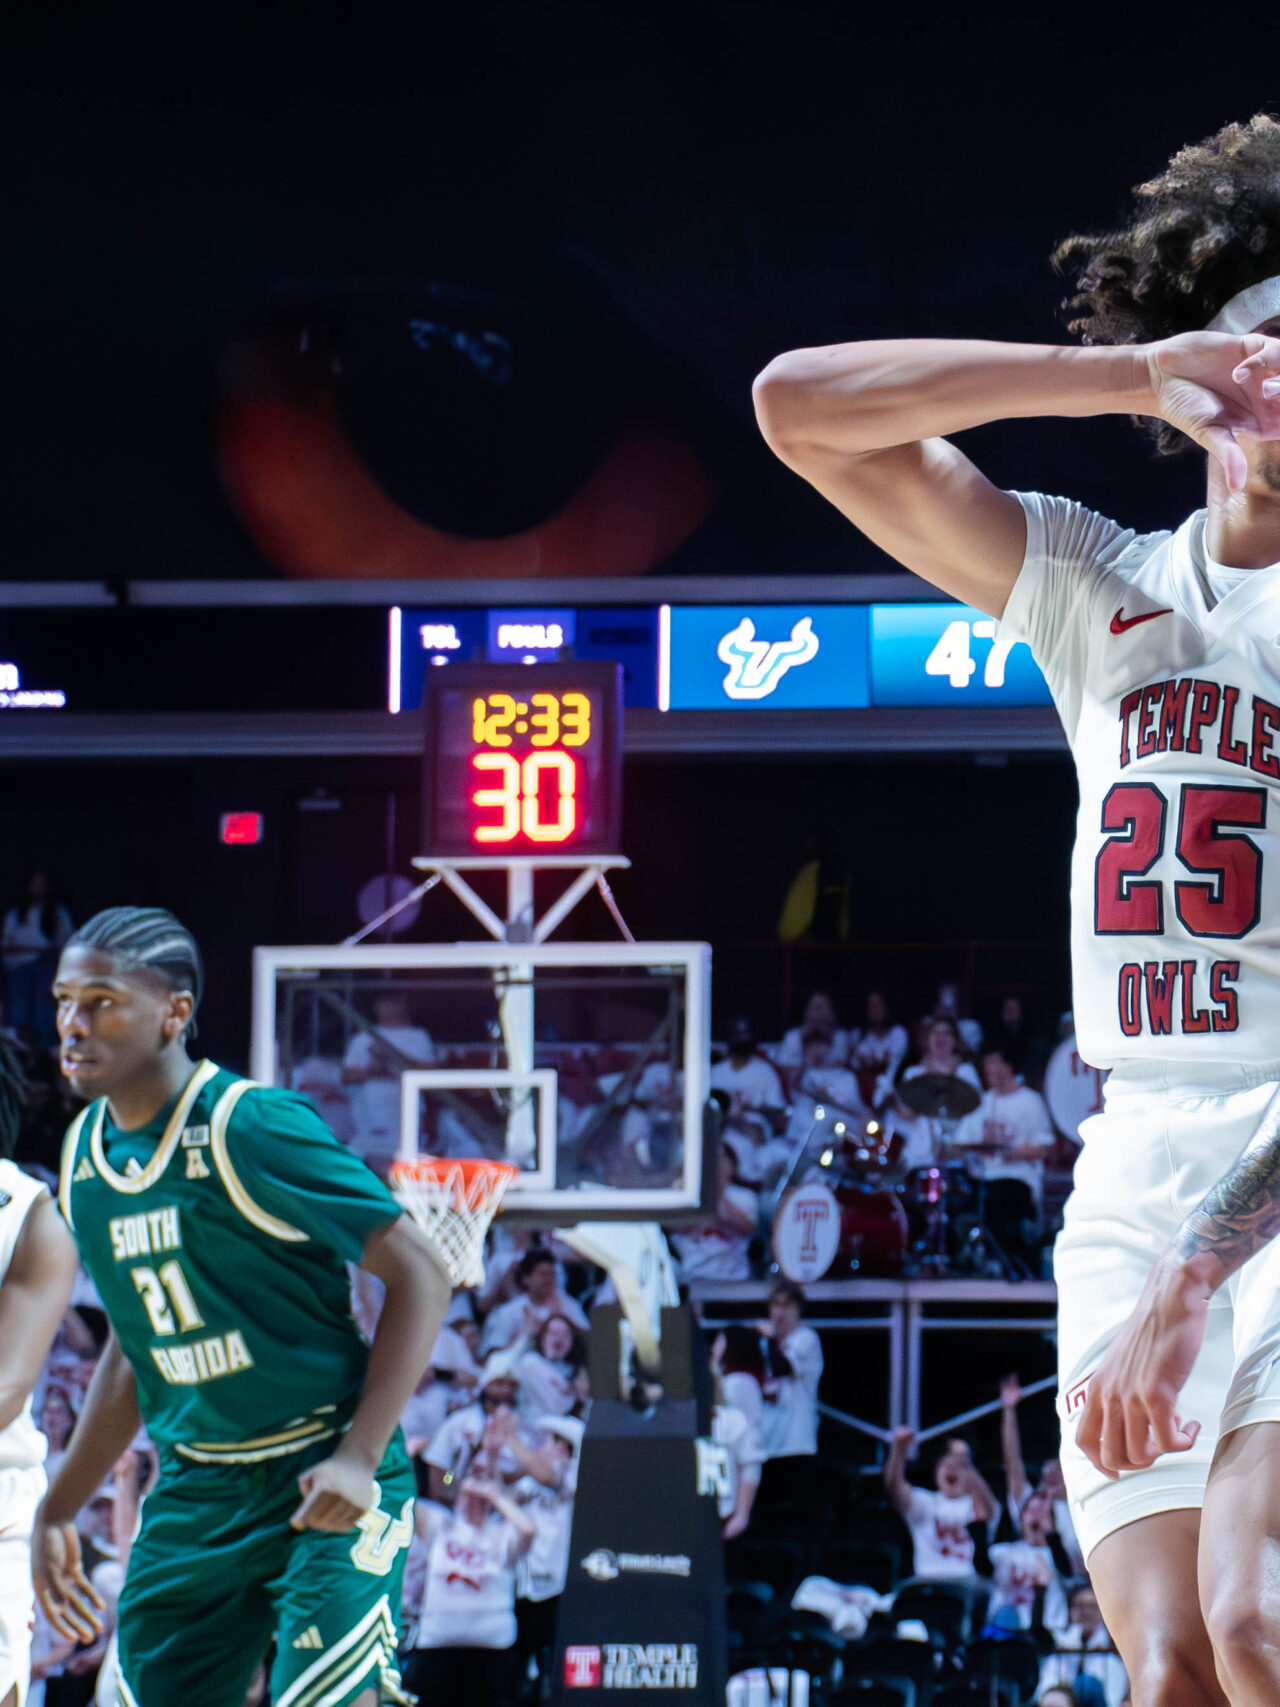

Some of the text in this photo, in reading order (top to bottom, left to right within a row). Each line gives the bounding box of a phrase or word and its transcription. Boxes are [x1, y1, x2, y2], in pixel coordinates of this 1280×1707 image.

[925, 620, 1014, 688] 47
[472, 692, 591, 747] 12:33
[471, 750, 577, 843] 30
[1094, 781, 1268, 939] 25
[1118, 960, 1240, 1037] OWLS
[109, 1205, 181, 1262] SOUTH
[130, 1259, 206, 1336] 21
[602, 1643, 697, 1664] TEMPLE
[602, 1664, 697, 1689] HEALTH
